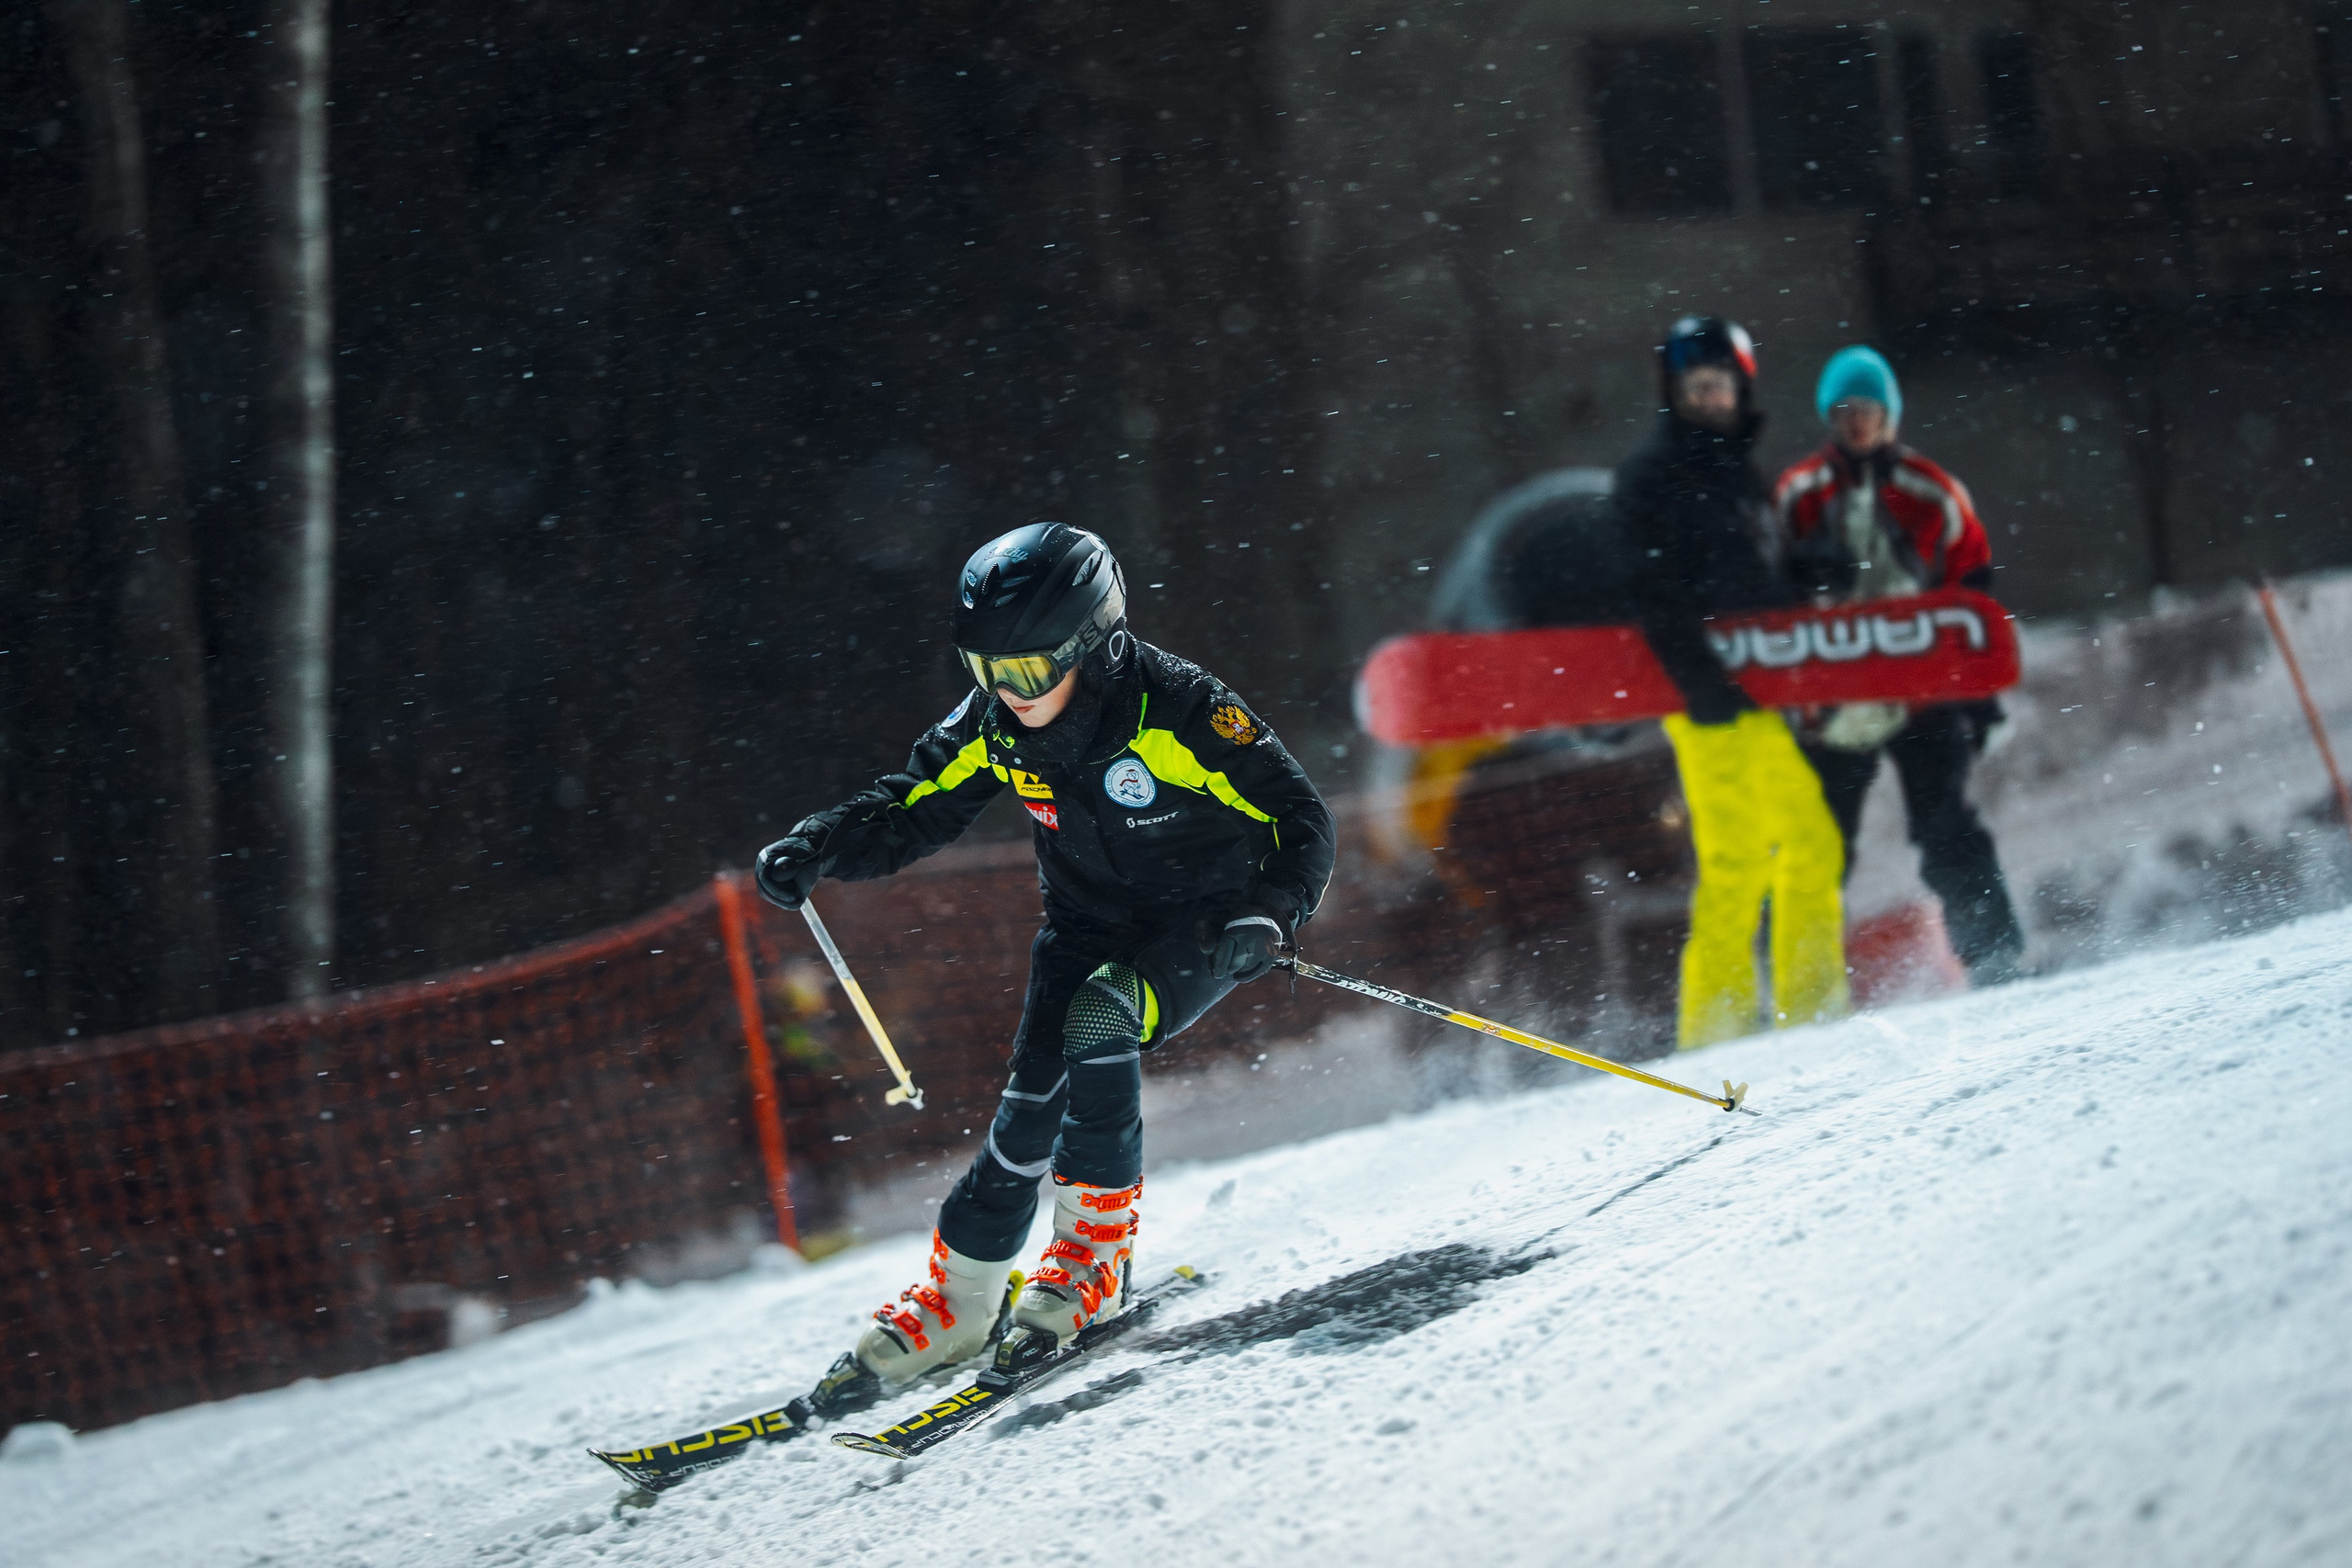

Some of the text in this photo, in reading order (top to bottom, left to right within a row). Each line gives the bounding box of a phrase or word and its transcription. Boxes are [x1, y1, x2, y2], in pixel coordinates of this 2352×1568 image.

[1136, 811, 1179, 826] SCOTT
[1337, 979, 1407, 1004] ATOMIC
[875, 1386, 993, 1443] FISCH
[602, 1411, 793, 1463] FISCH
